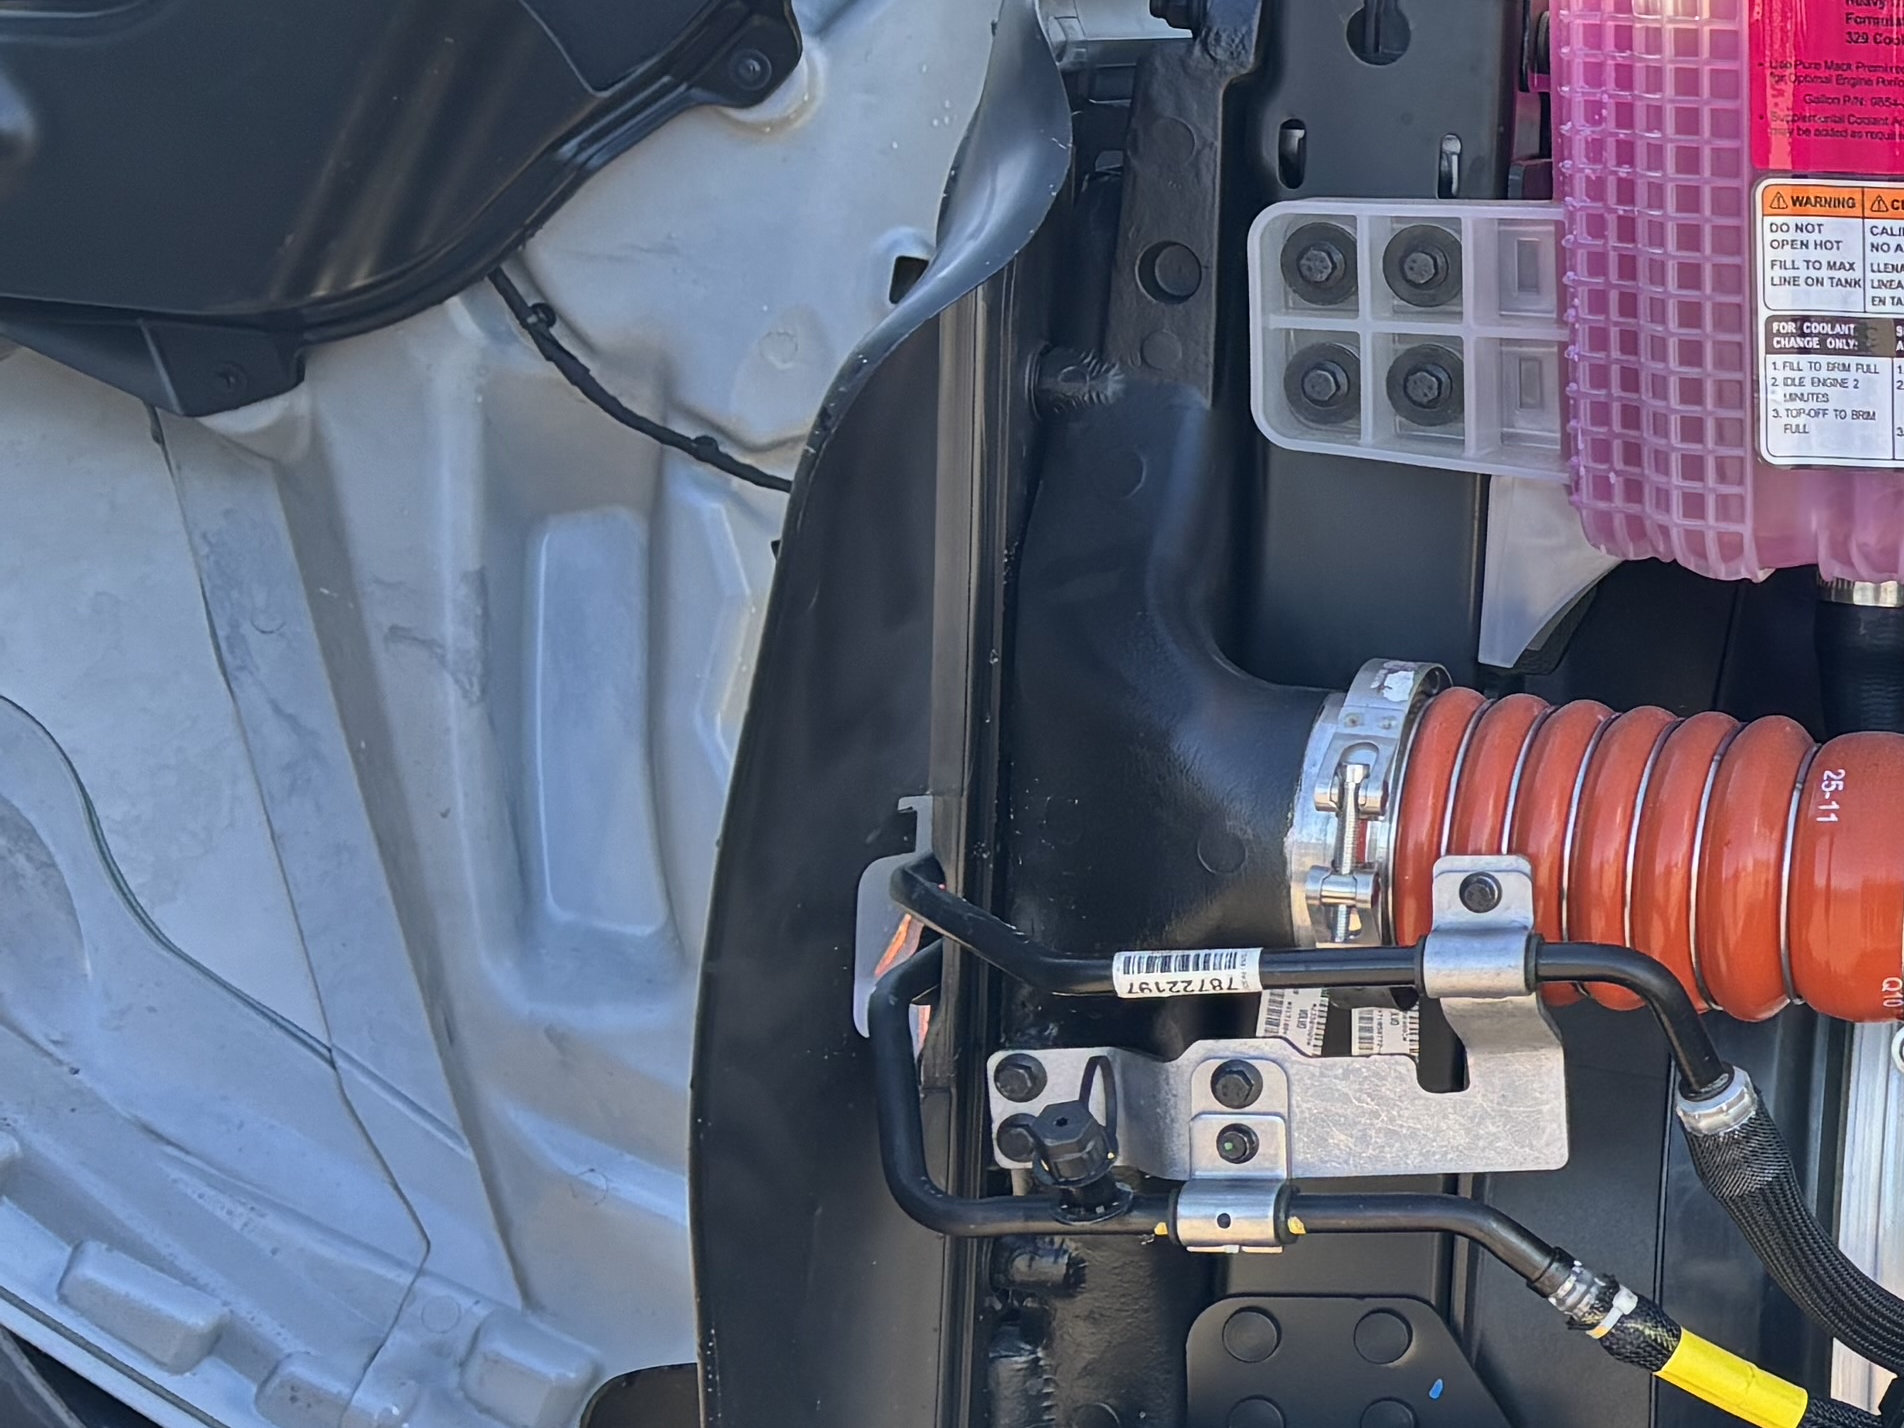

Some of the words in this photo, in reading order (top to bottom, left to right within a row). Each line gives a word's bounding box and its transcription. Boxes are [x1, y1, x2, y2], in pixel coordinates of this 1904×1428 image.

[1791, 196, 1857, 210] WARNING
[1769, 222, 1790, 234] DO
[1794, 223, 1824, 234] NOT
[1770, 239, 1809, 251] OPEN
[1813, 239, 1843, 251] HOT
[1870, 242, 1892, 254] NO
[1770, 259, 1800, 271] FILL
[1803, 260, 1822, 271] TO
[1826, 260, 1857, 272] MAX
[1770, 275, 1801, 288] LINE
[1804, 276, 1825, 288] ON
[1827, 276, 1862, 289] TANK
[1871, 295, 1887, 307] EN
[1773, 322, 1797, 335] FOR
[1802, 322, 1855, 335] COOLANT
[1773, 337, 1821, 350] CHANGE
[1826, 338, 1859, 350] ONLY:
[1782, 361, 1804, 372] FILL
[1807, 361, 1822, 372] TO
[1855, 362, 1880, 374] FULL
[1782, 377, 1806, 388] IDLE
[1810, 377, 1850, 389] ENGINE
[1853, 378, 1860, 389] 2
[1783, 392, 1830, 404] MINUTES
[1784, 408, 1829, 420] TOP-OFF
[1833, 408, 1847, 420] TO
[1783, 422, 1810, 435] FULL
[1815, 768, 1846, 823] 25-11
[1881, 976, 1904, 1009] Q10
